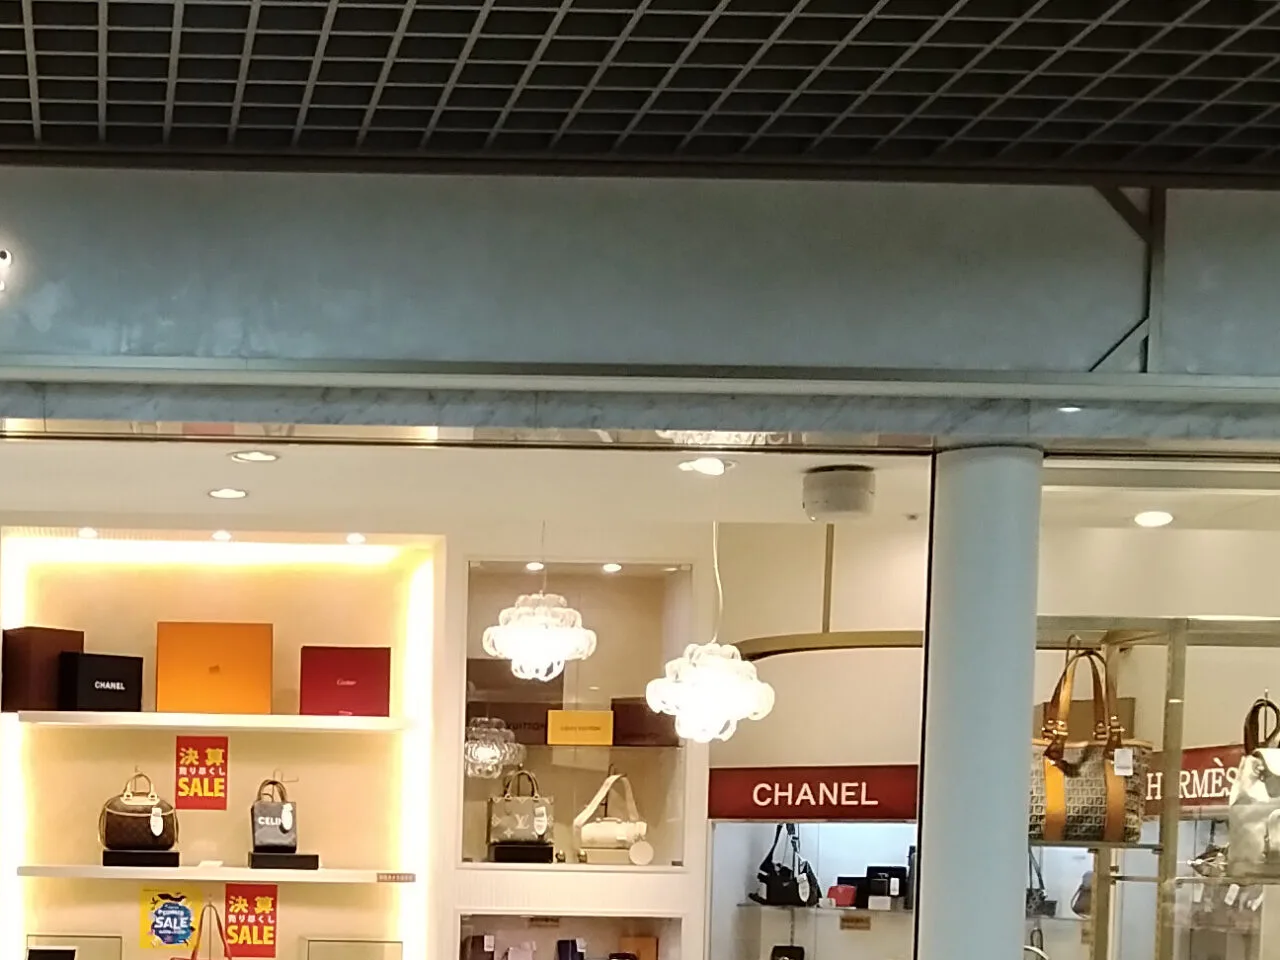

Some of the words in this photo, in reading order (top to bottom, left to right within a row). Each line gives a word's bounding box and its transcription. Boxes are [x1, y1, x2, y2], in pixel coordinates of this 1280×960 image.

[94, 680, 125, 690] CHANEL
[180, 747, 225, 766] 決算
[178, 777, 225, 797] SALE
[1145, 757, 1239, 800] HRMÈS
[752, 781, 879, 807] CHANEL
[228, 896, 275, 914] 決算
[154, 916, 189, 930] SALE
[227, 925, 274, 945] SALE
